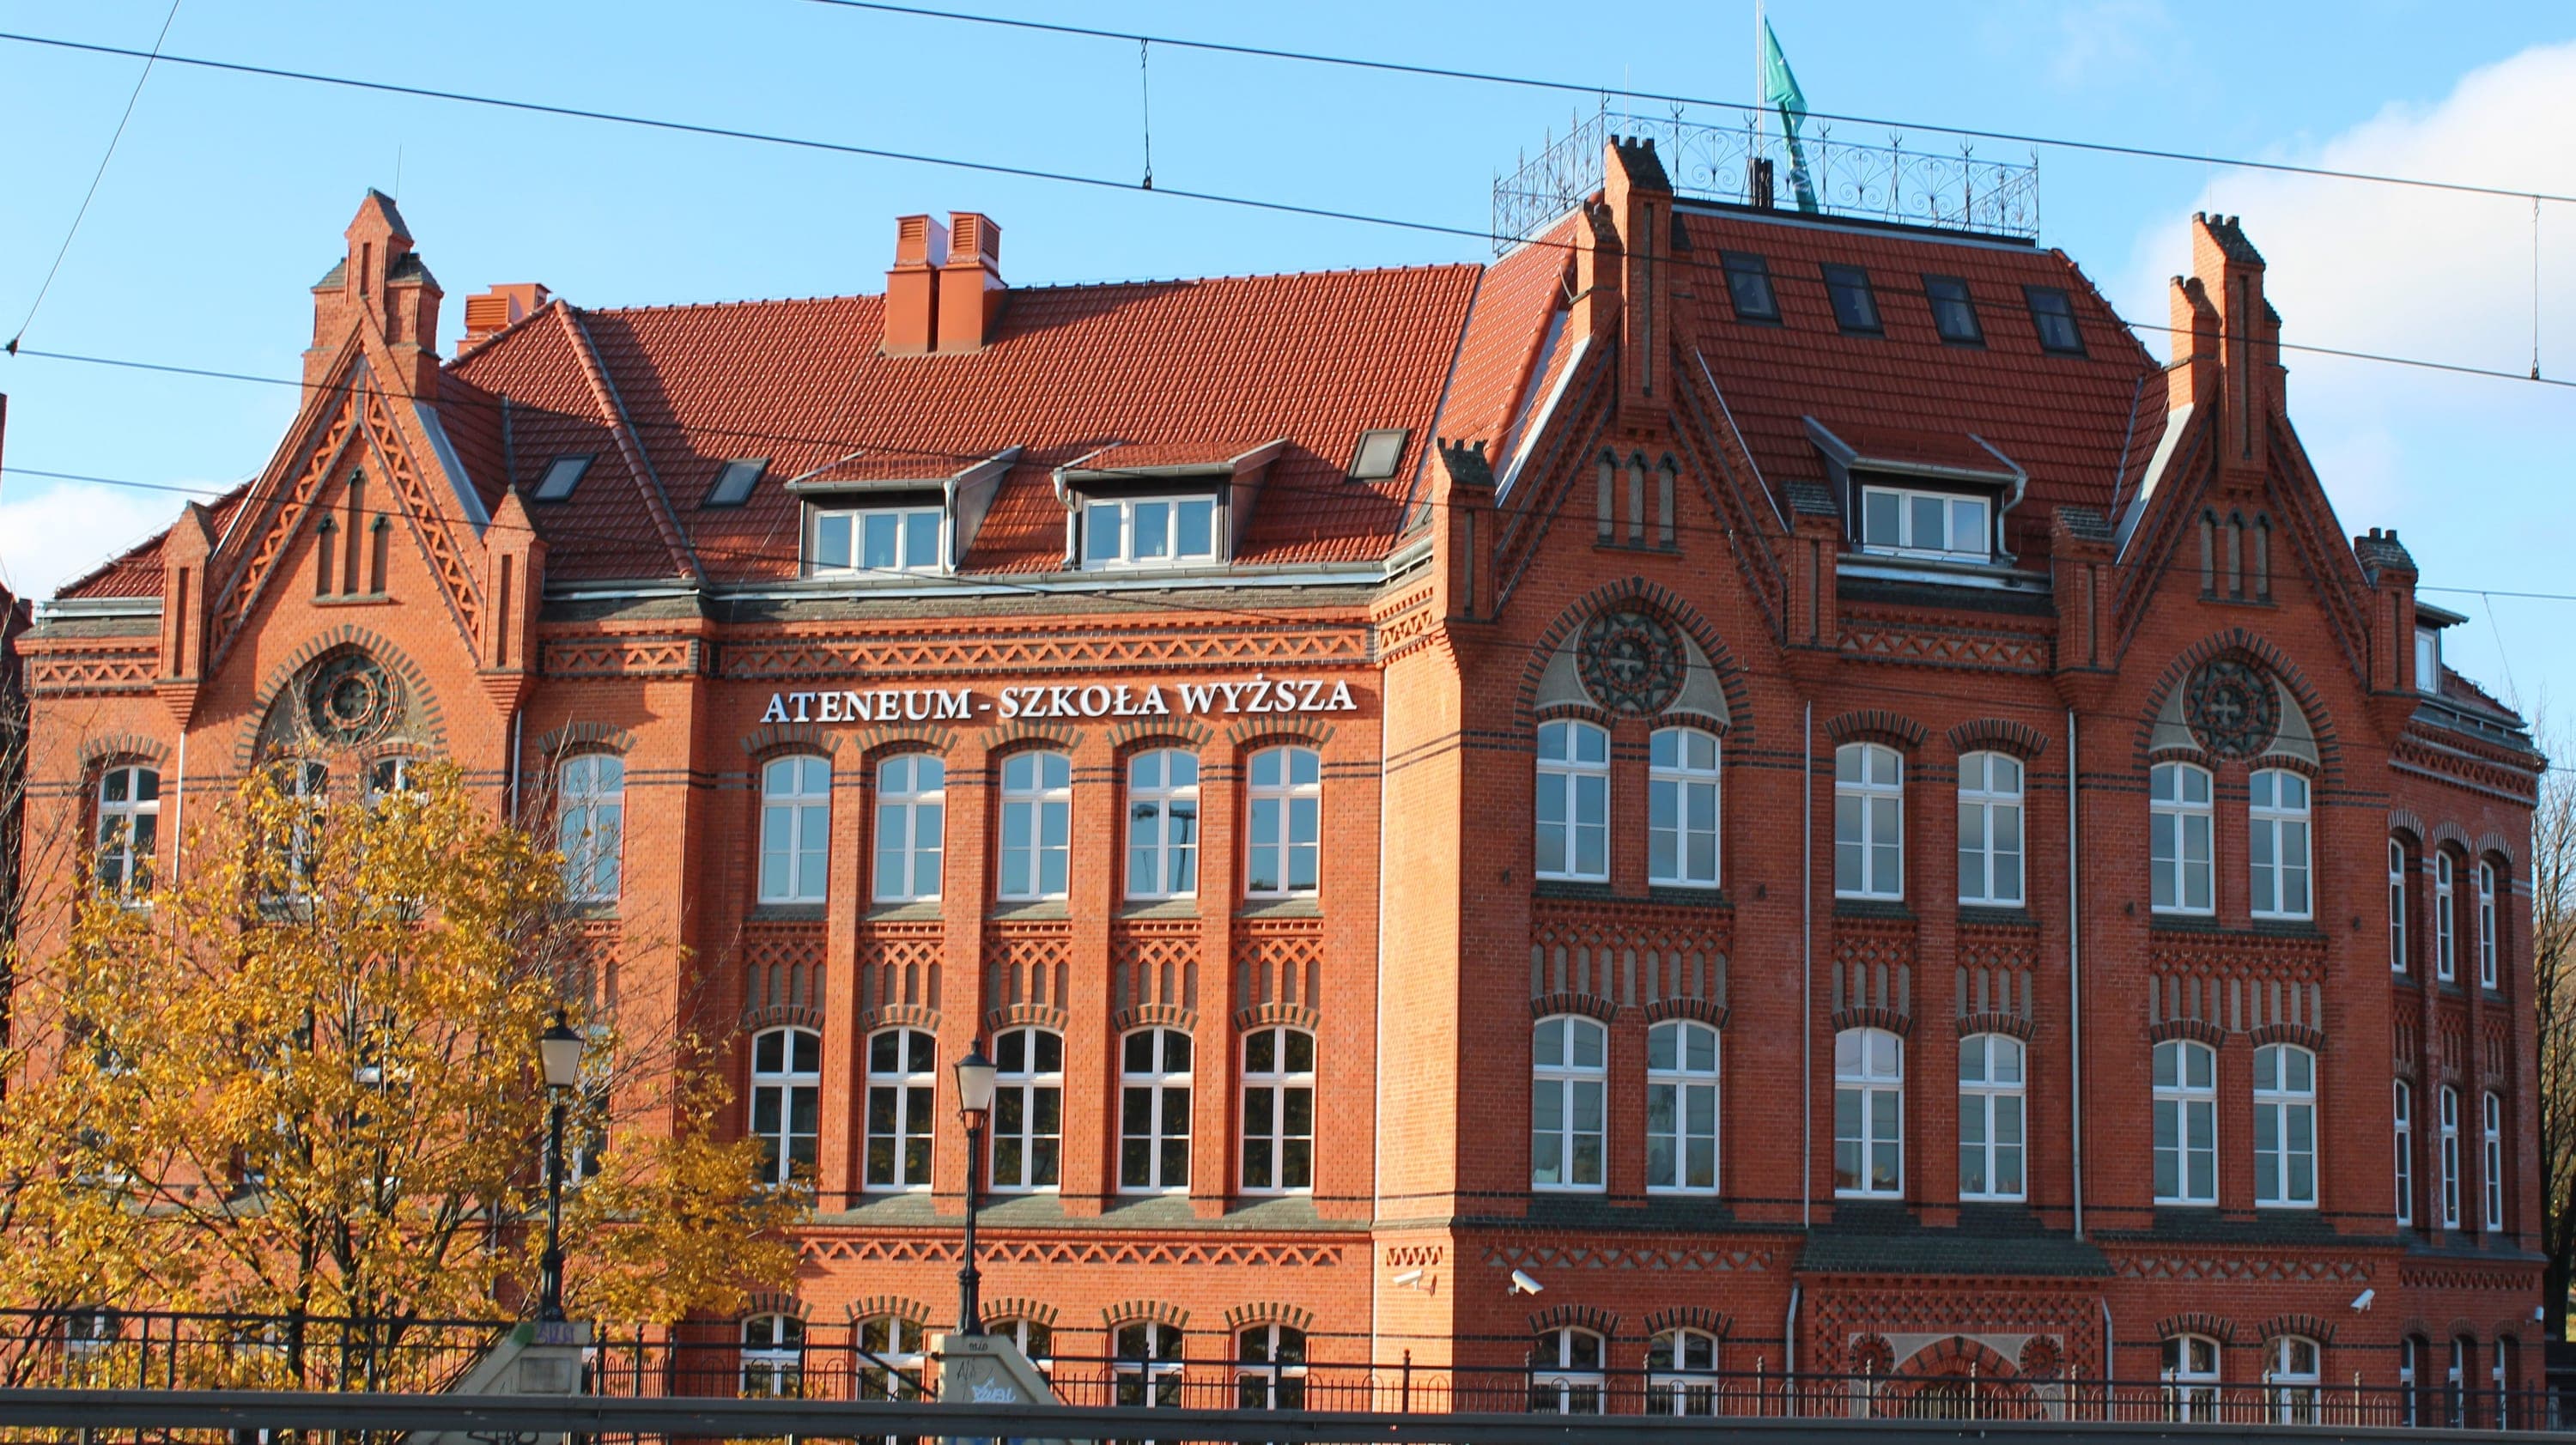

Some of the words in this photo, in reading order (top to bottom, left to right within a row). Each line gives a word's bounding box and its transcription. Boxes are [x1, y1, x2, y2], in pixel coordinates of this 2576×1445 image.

[760, 688, 972, 723] ATENEUM
[998, 684, 1170, 718] SZKOŁA
[1177, 673, 1358, 714] WYŻSZA
